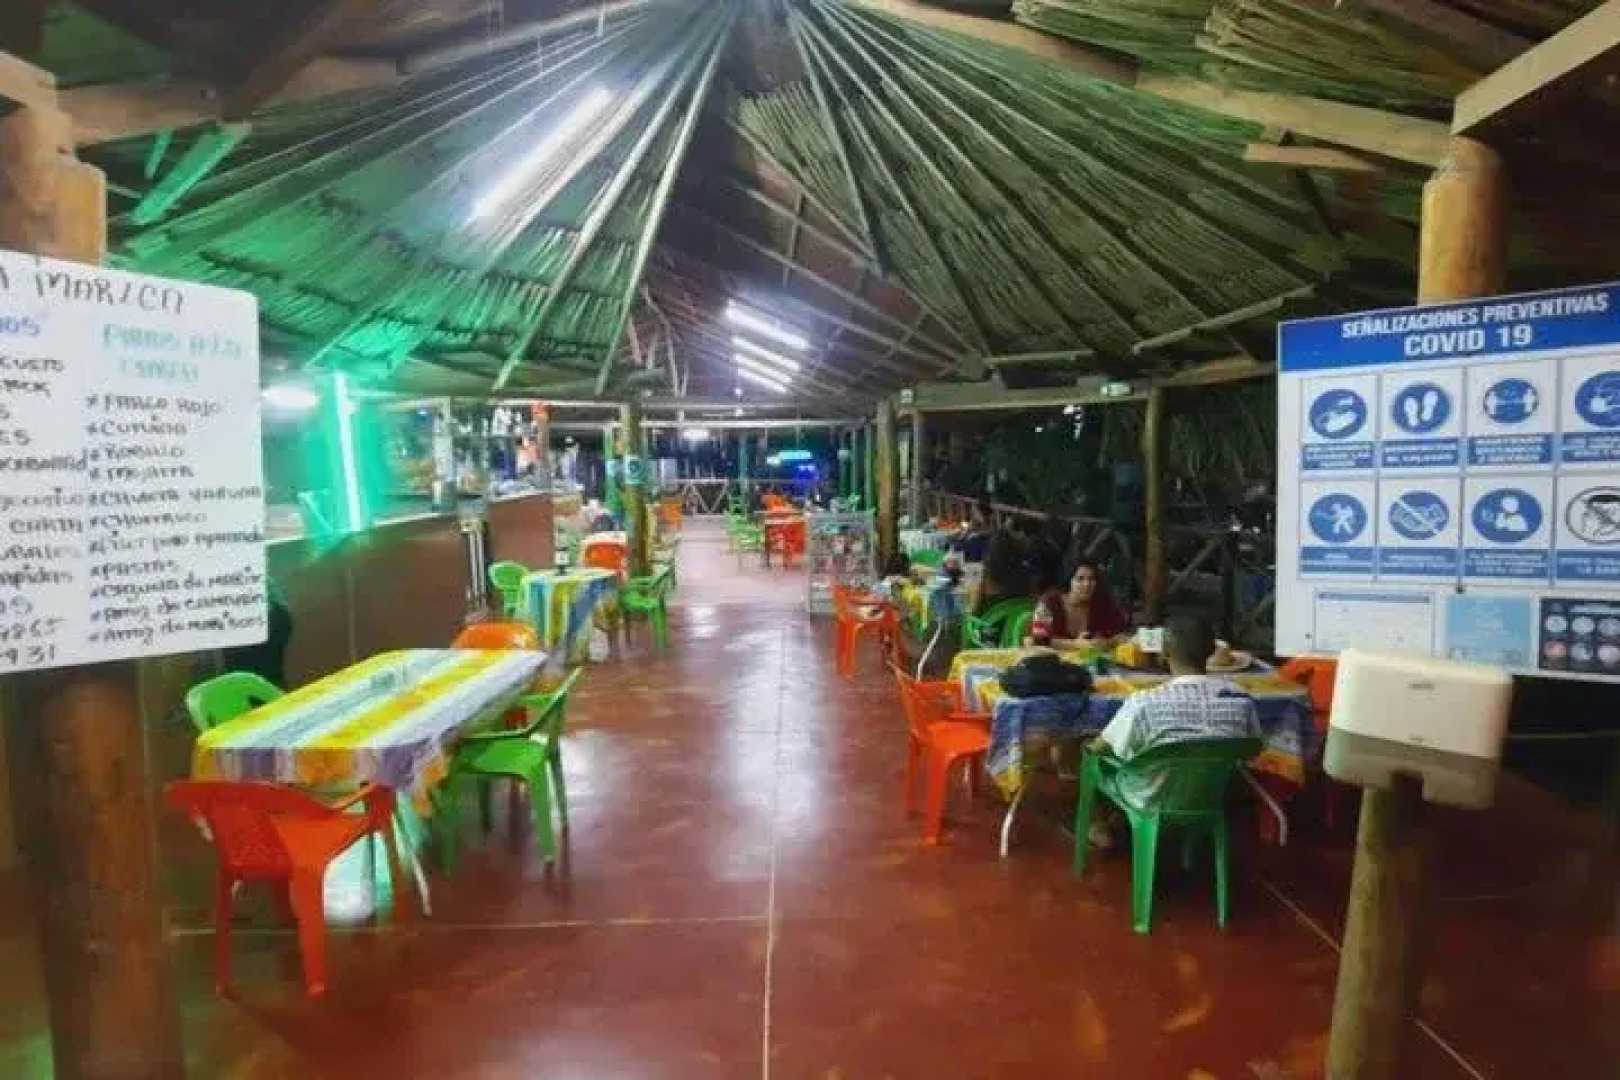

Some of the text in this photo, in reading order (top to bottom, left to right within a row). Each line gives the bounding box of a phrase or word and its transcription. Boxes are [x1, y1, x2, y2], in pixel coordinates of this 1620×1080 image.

[1482, 291, 1610, 323] PREVENTIVAS
[1404, 323, 1532, 357] COVID 19
